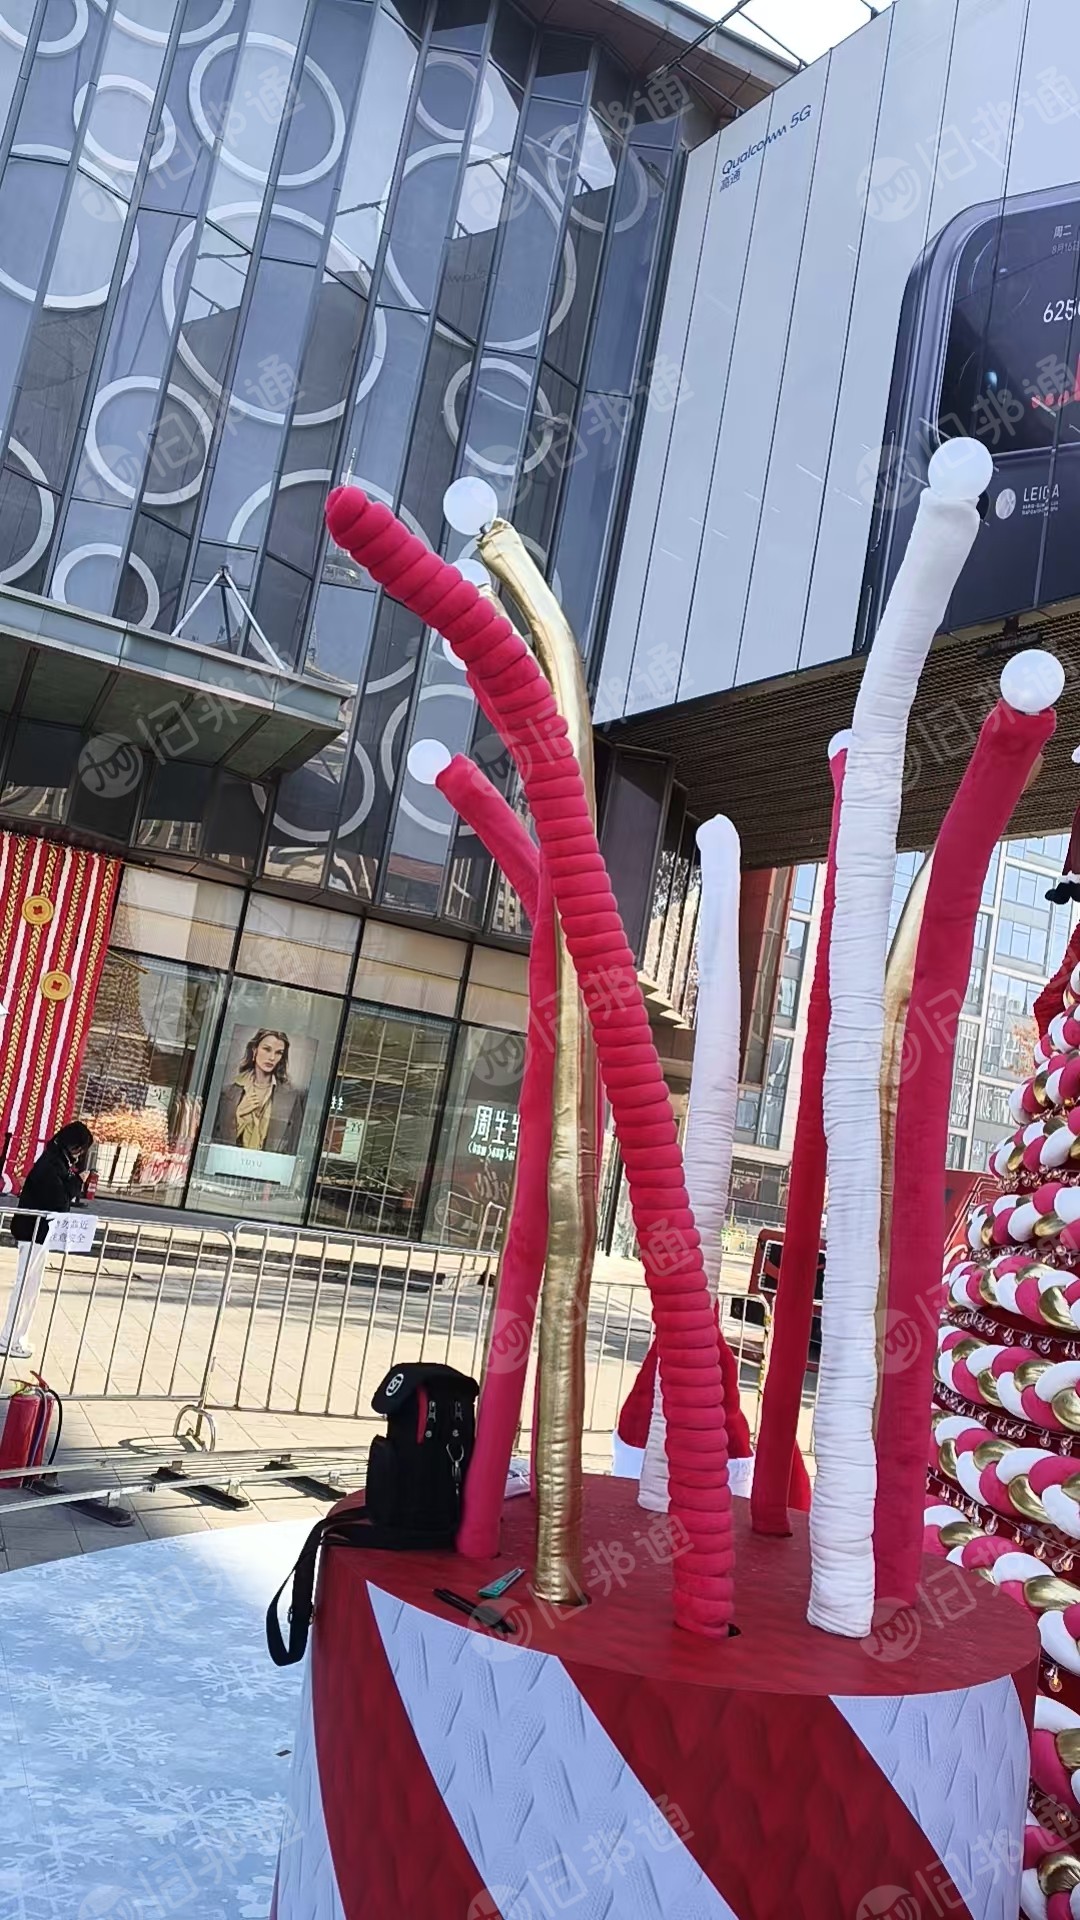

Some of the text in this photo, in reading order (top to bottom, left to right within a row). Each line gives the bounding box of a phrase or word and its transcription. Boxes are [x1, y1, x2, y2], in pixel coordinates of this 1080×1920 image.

[722, 104, 812, 175] Qualcomm 5G
[719, 167, 742, 193] 高通
[1053, 224, 1072, 239] 周二
[1043, 298, 1080, 323] 625
